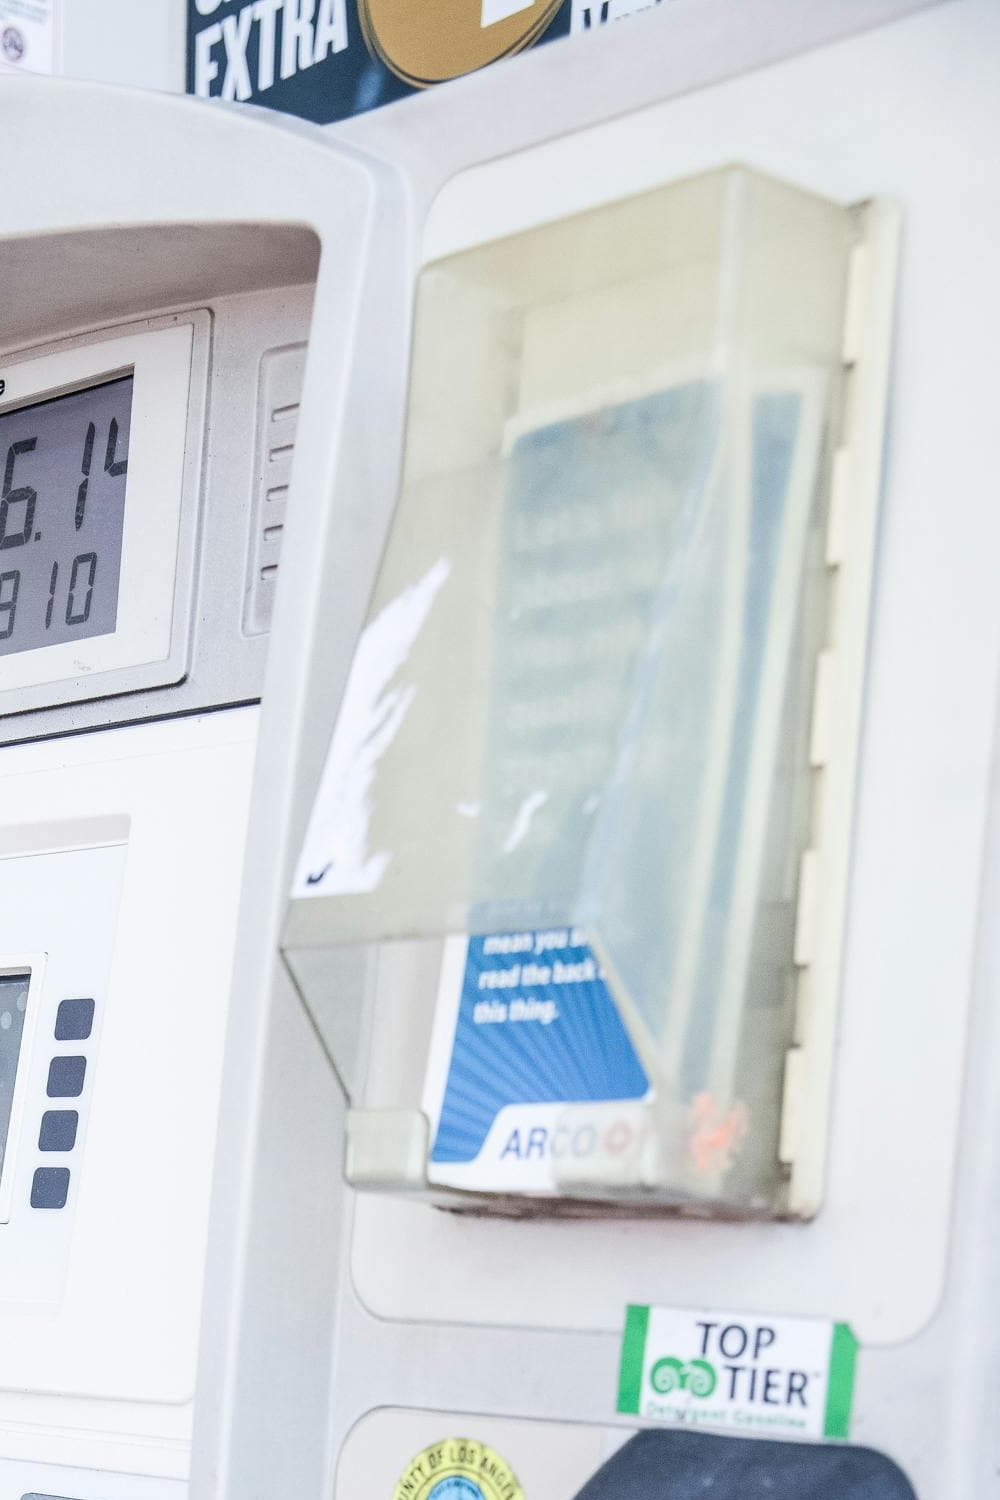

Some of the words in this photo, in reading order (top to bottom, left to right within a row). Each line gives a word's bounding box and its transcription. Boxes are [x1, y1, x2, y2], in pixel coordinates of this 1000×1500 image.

[195, 0, 348, 101] EXTRA
[478, 964, 519, 990] read
[521, 962, 549, 987] the
[474, 1001, 507, 1024] this
[501, 1123, 597, 1159] ARCO
[696, 1321, 776, 1359] TOP
[723, 1364, 809, 1406] TIER
[428, 1449, 443, 1469] OF
[450, 1447, 475, 1464] LOS
